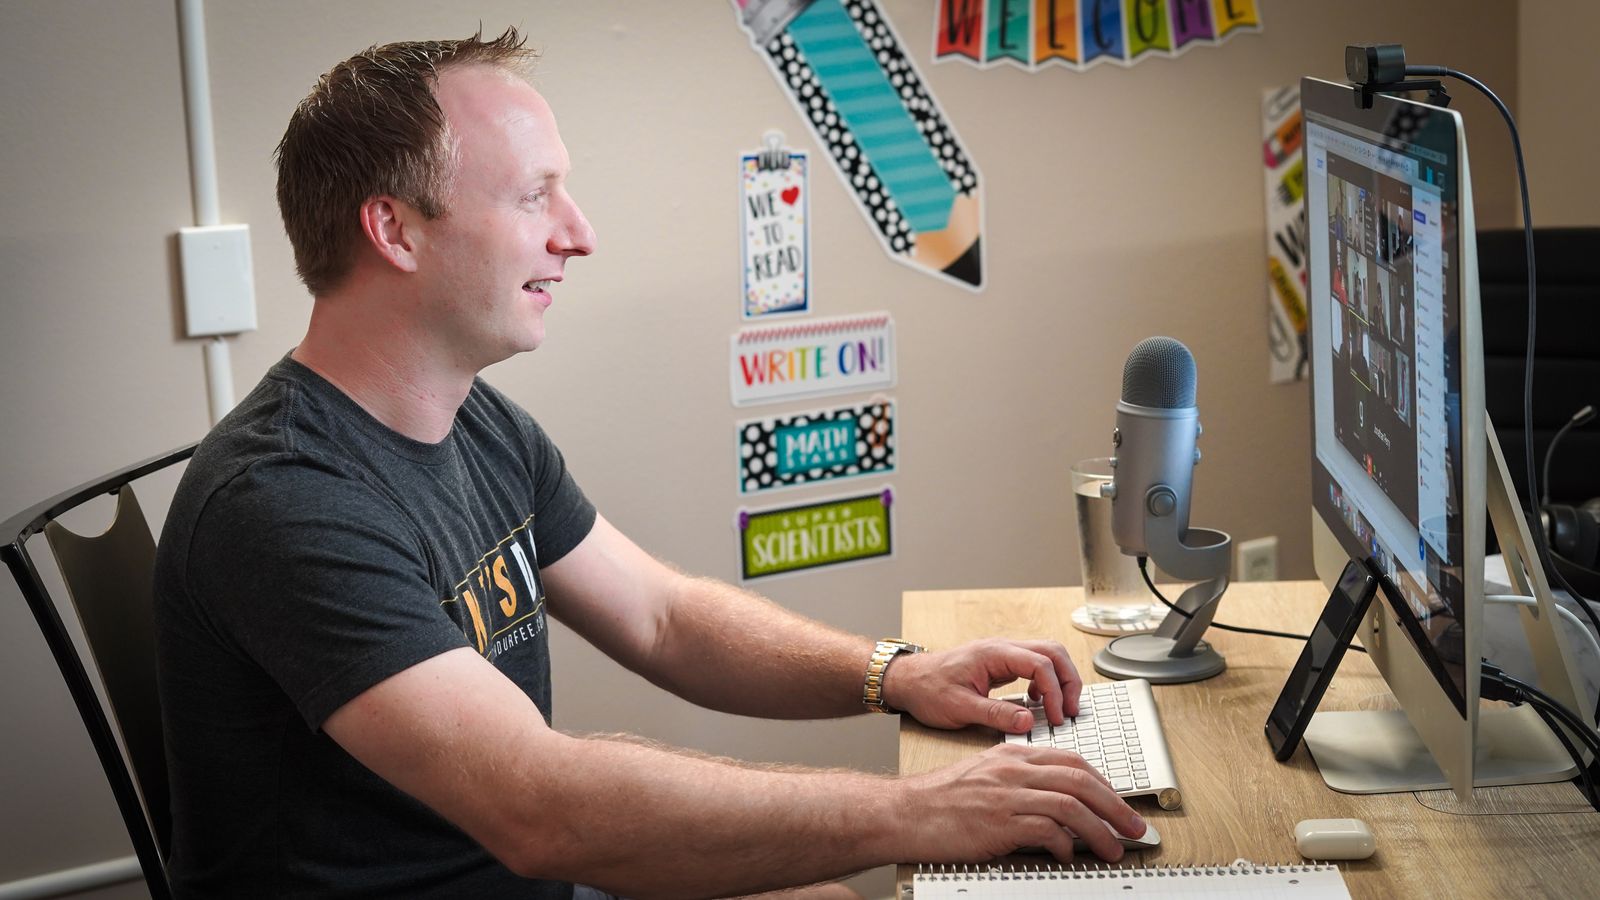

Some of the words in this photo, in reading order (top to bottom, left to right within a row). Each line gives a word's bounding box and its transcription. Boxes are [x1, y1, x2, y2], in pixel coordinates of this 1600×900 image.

[748, 190, 780, 219] WE
[763, 222, 783, 246] TO
[753, 245, 801, 281] READ
[739, 345, 830, 386] WRITE
[837, 336, 884, 375] ON!
[785, 426, 848, 456] MATH
[782, 507, 852, 529] SUPER
[752, 516, 881, 568] SCIENTISTS
